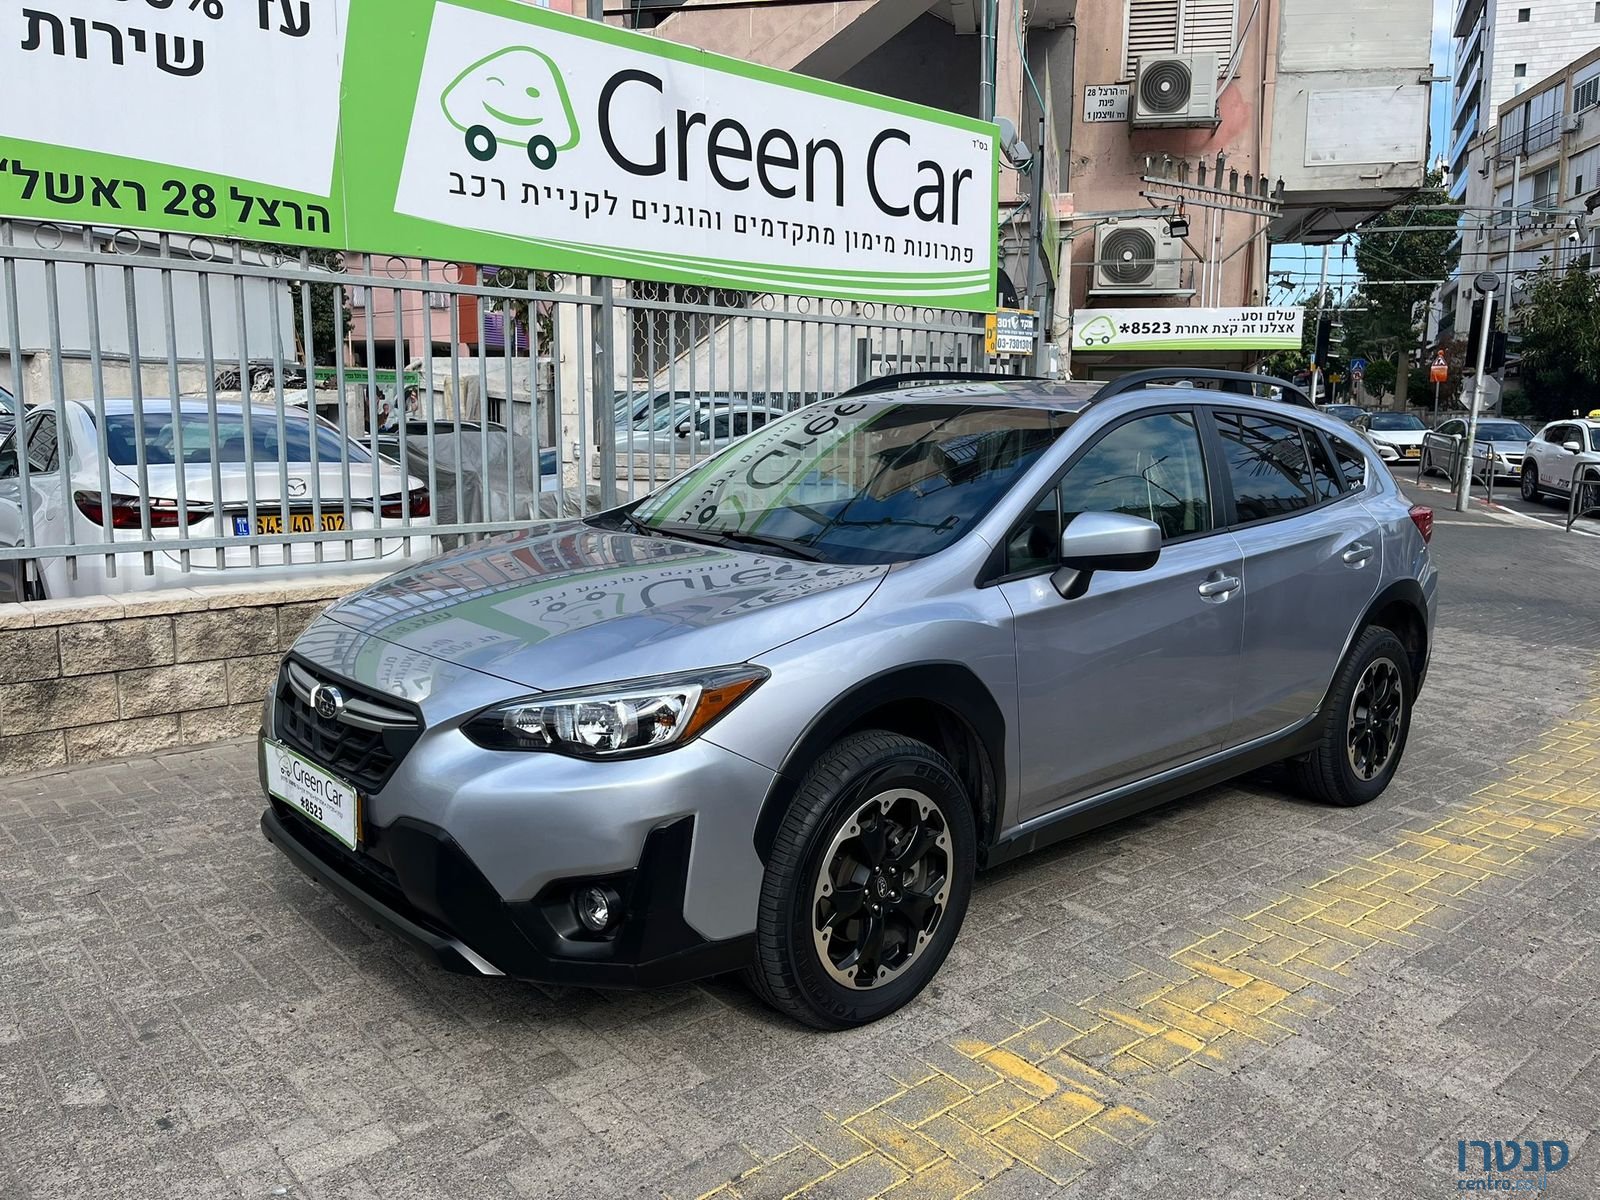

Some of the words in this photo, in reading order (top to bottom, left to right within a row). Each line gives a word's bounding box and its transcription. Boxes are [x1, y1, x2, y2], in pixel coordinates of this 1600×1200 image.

[258, 0, 310, 37] עד
[21, 8, 204, 77] שירות
[1087, 88, 1096, 97] 28
[1098, 86, 1118, 96] הרצל
[1098, 99, 1115, 107] פינת
[1087, 111, 1091, 119] 1
[597, 69, 844, 208] Green
[867, 128, 973, 226] Car
[972, 139, 988, 151] בס"ד
[0, 158, 147, 211] ראשל
[449, 171, 506, 201] רכב
[161, 179, 217, 219] 28
[230, 186, 330, 234] הרצל
[521, 182, 618, 219] לקניית
[632, 199, 721, 231] והוגנים
[734, 214, 835, 246] מתקדמים
[845, 230, 895, 253] מימון
[903, 238, 974, 264] פתרונות
[1228, 311, 1263, 322] וסע...
[1267, 310, 1296, 321] שלם
[1175, 325, 1208, 335] אחרת
[1211, 324, 1238, 336] קצת
[1242, 324, 1256, 334] זה
[1259, 322, 1294, 334] אצלנו
[293, 760, 323, 796] Green
[325, 780, 343, 808] Car
